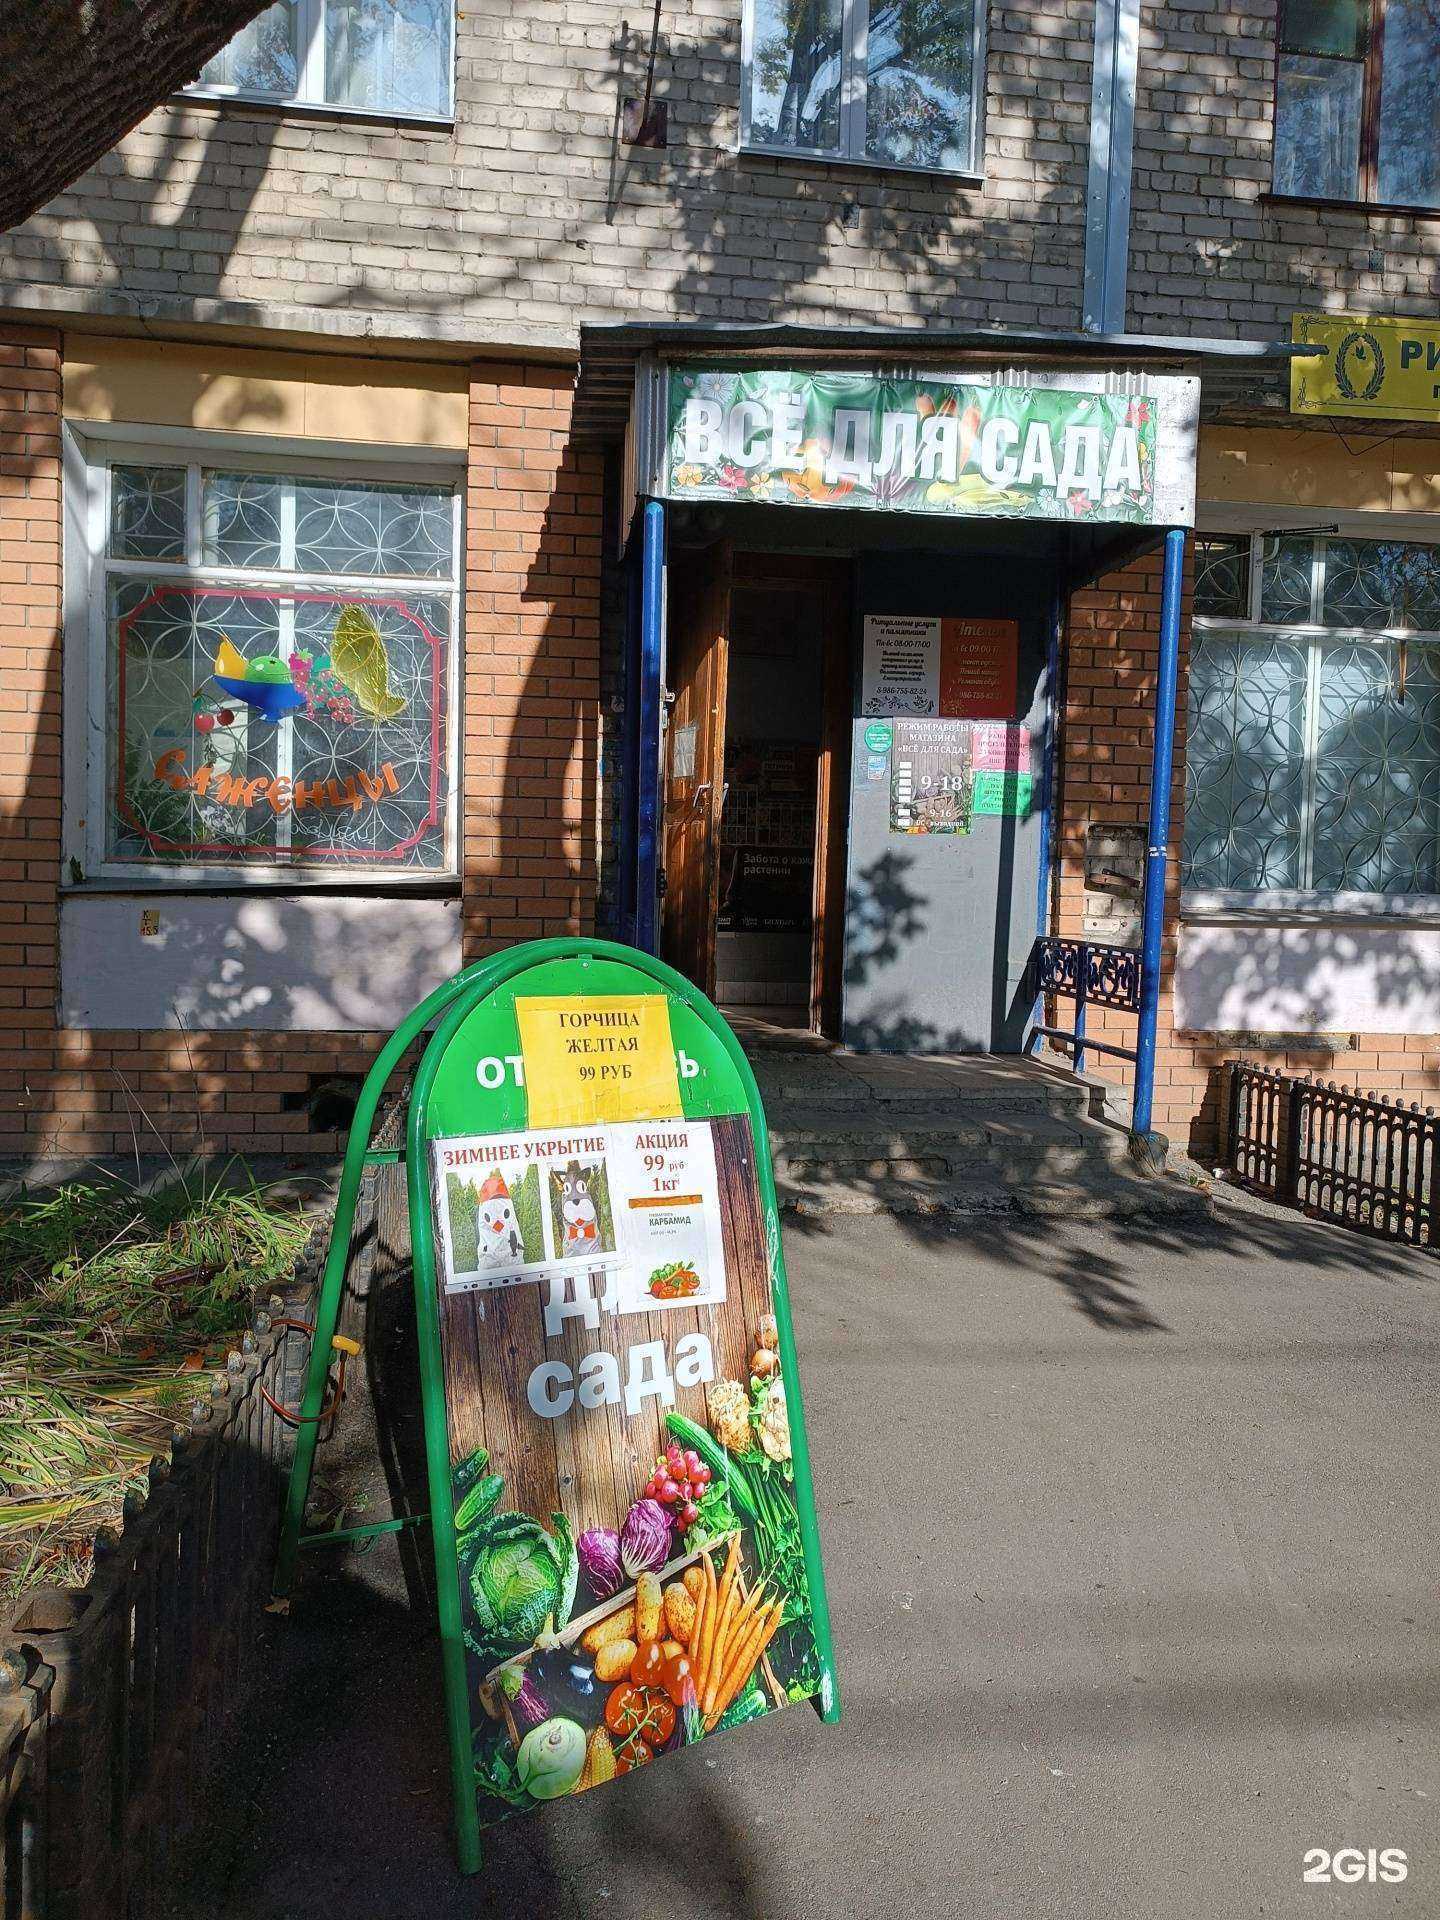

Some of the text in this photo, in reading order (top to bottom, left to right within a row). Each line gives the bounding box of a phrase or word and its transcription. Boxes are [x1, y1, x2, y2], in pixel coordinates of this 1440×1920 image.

[684, 391, 1142, 500] ВСЁ ДЛЯ САДА
[897, 722, 969, 732] РЕЖИМ РАБОТЫ
[909, 734, 956, 742] МАГАЗИНА
[920, 745, 940, 754] ДЛЯ
[921, 775, 963, 791] 9-18
[743, 853, 779, 864] Забота
[559, 1011, 640, 1029] ГОРЧИЦА
[566, 1037, 639, 1053] ЖЕЛТАЯ
[579, 1064, 633, 1081] 99 РУБ
[635, 1133, 689, 1151] АКЦИЯ
[443, 1136, 606, 1166] ЗИМНЕЕ УКРЫТИЕ
[643, 1154, 685, 1172] 99 руб
[652, 1177, 680, 1192] 1кг
[649, 1215, 692, 1226] КАРБАМИД
[527, 1332, 714, 1419] сада
